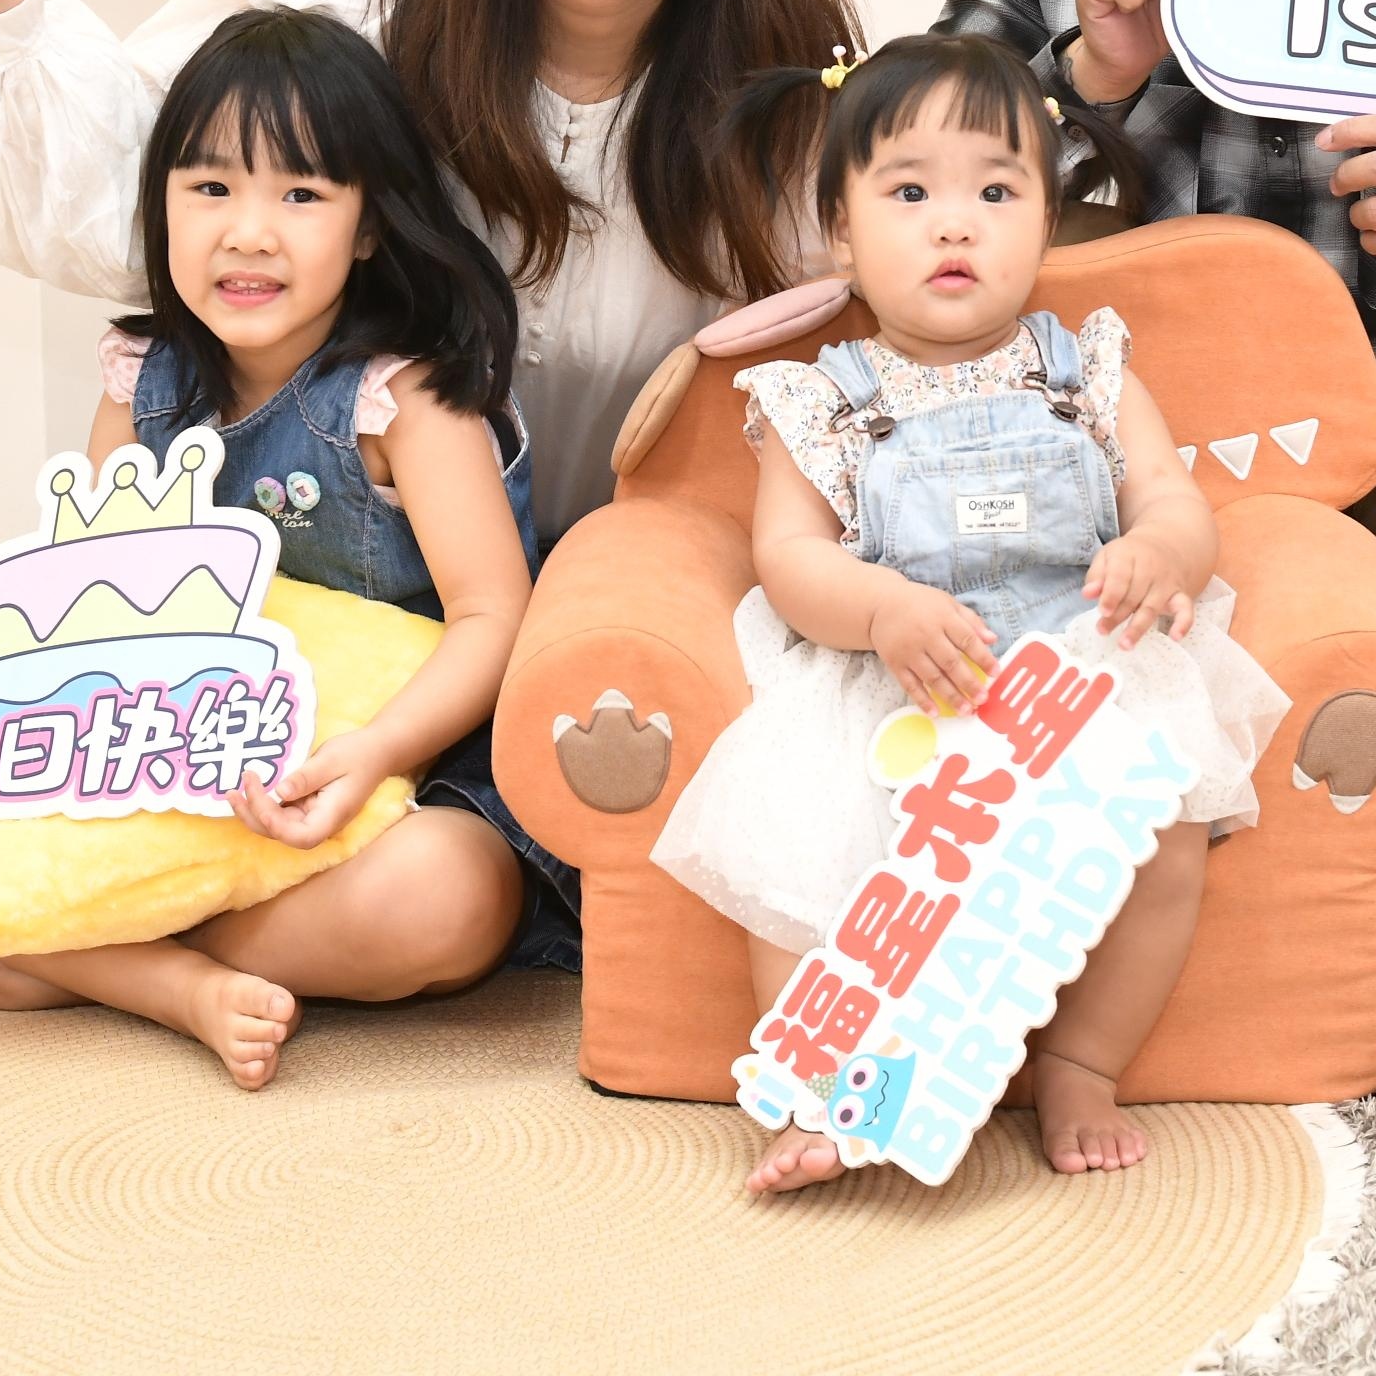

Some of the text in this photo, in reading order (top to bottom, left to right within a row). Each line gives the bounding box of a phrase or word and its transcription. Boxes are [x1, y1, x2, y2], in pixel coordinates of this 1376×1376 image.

[760, 639, 1115, 1083] 福星本星
[890, 754, 1101, 1057] HAPPY
[890, 729, 1192, 1176] BIRTHDAY
